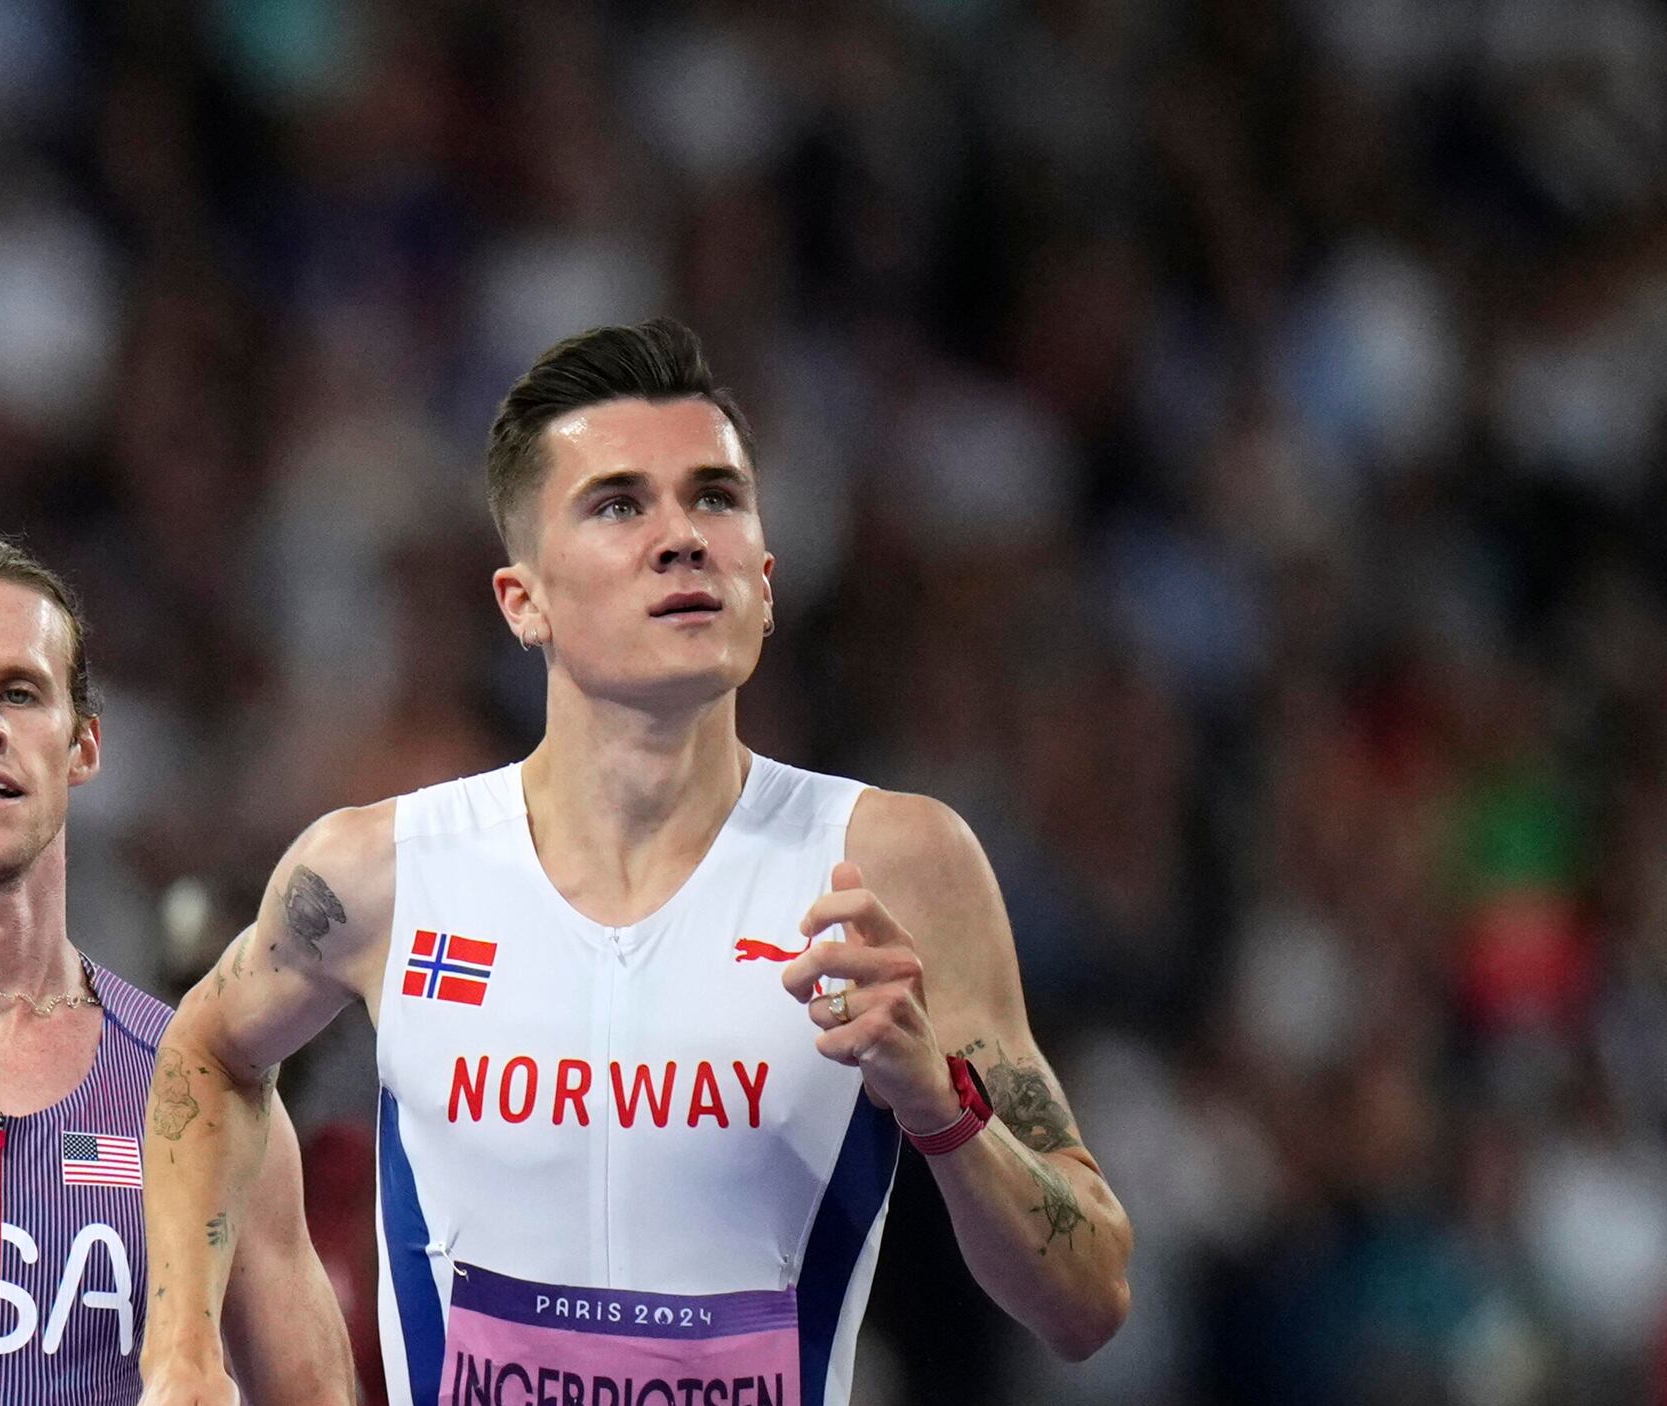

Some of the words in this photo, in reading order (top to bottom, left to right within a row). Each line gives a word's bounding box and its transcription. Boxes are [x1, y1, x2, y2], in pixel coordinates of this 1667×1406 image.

[448, 1055, 769, 1129] NORWAY
[536, 1295, 621, 1322] PARIS
[634, 1304, 712, 1327] 2024
